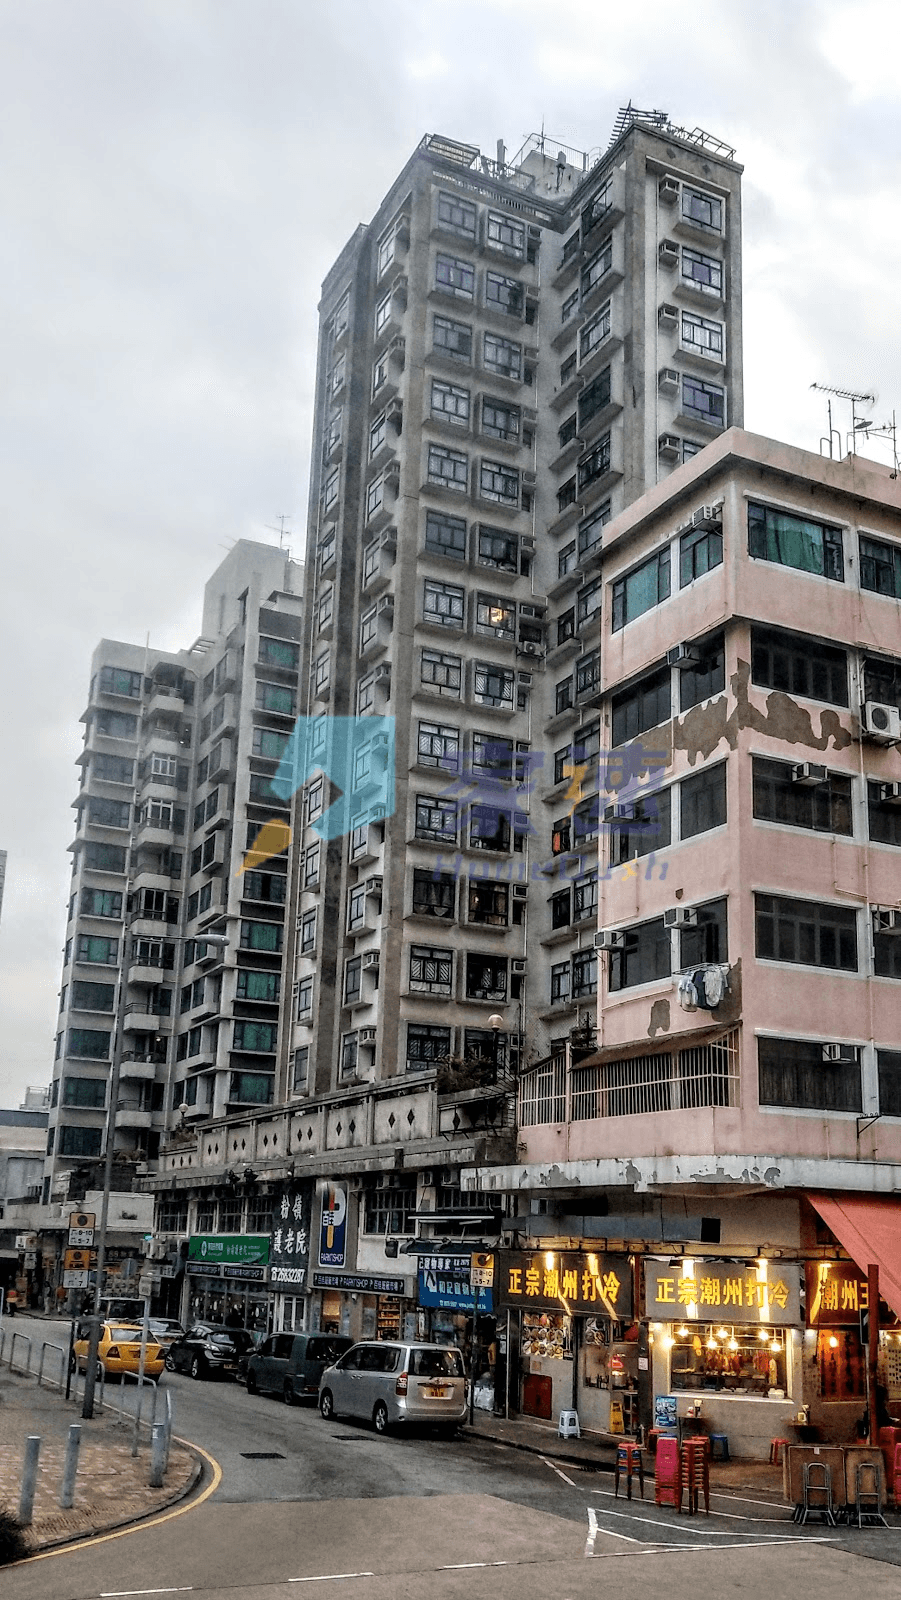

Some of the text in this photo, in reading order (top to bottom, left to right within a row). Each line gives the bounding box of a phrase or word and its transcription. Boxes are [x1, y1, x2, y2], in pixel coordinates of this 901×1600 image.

[280, 1194, 303, 1221] 粉嶺
[273, 1228, 307, 1255] 護老院
[507, 1267, 621, 1304] 正宗潮州打冷
[655, 1276, 789, 1310] 正宗潮州打冷
